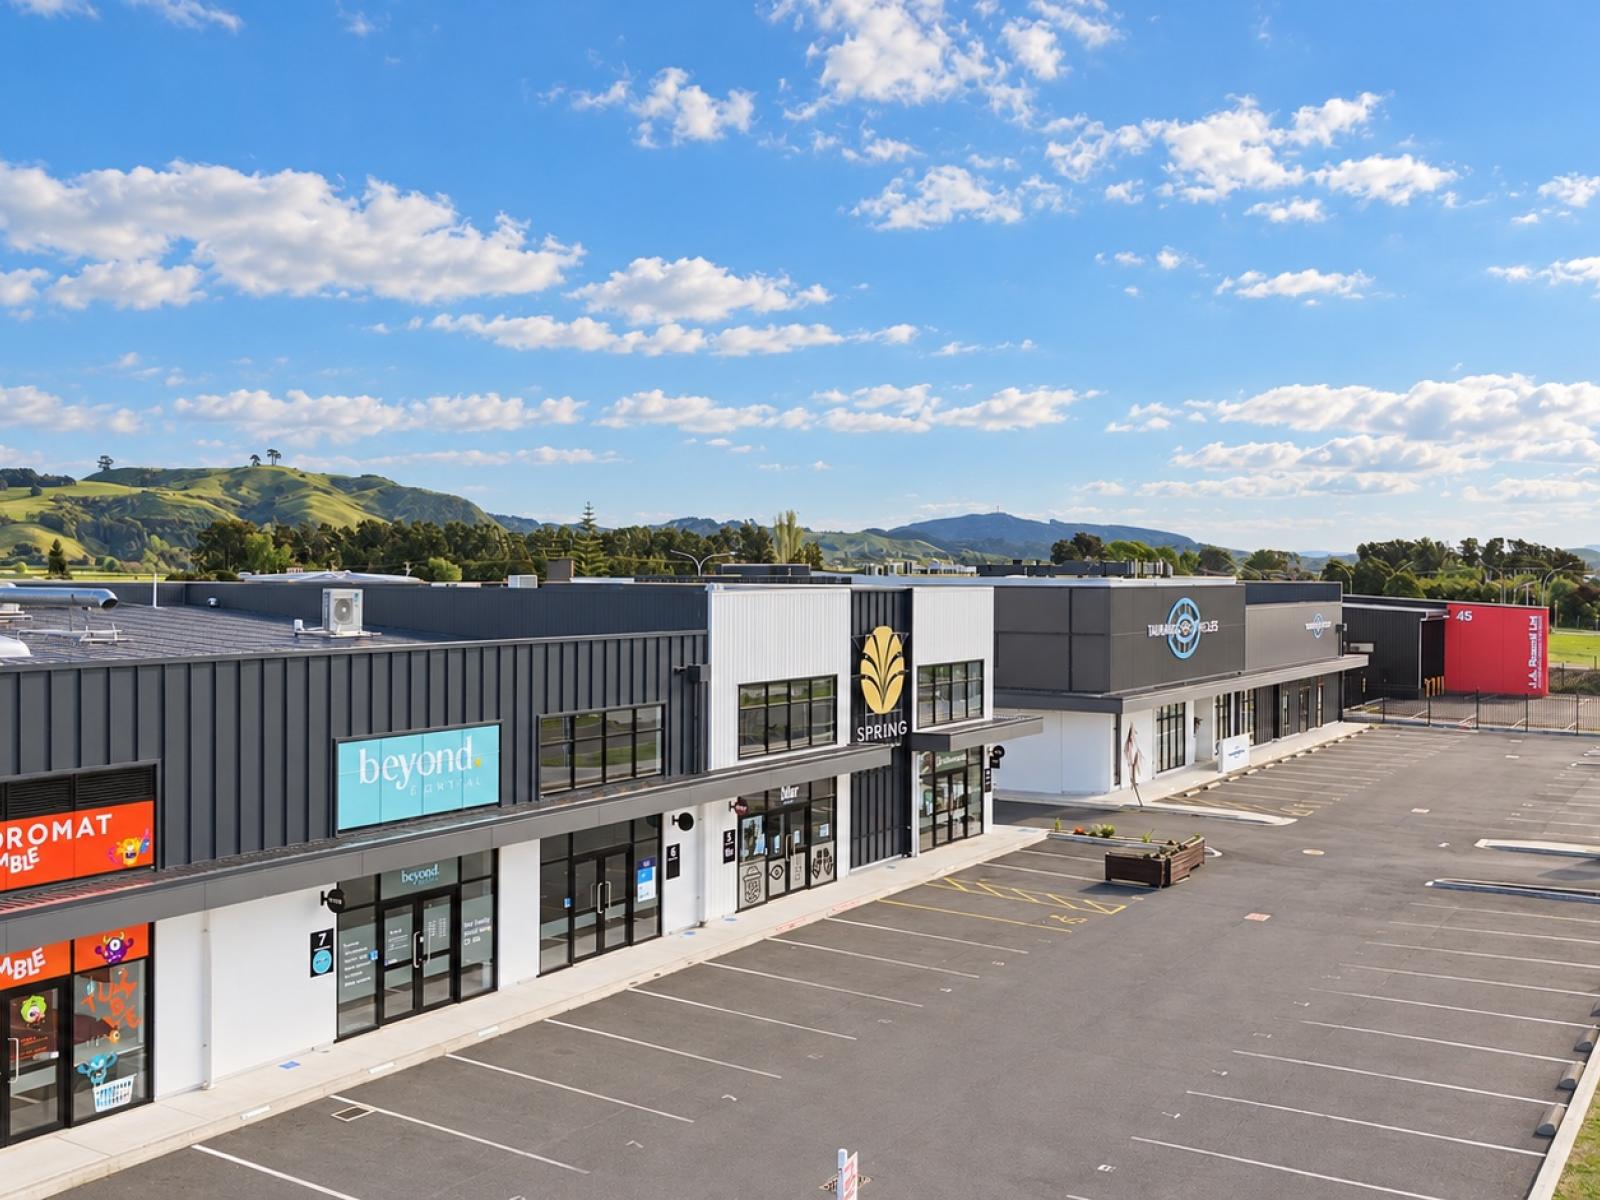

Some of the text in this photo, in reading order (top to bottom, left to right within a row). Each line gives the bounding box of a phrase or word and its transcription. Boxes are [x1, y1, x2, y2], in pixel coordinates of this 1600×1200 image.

[1456, 611, 1472, 621] 45
[857, 720, 907, 742] SPRING
[0, 813, 112, 849] ROMAT
[670, 847, 677, 857] 6
[318, 932, 327, 946] 7
